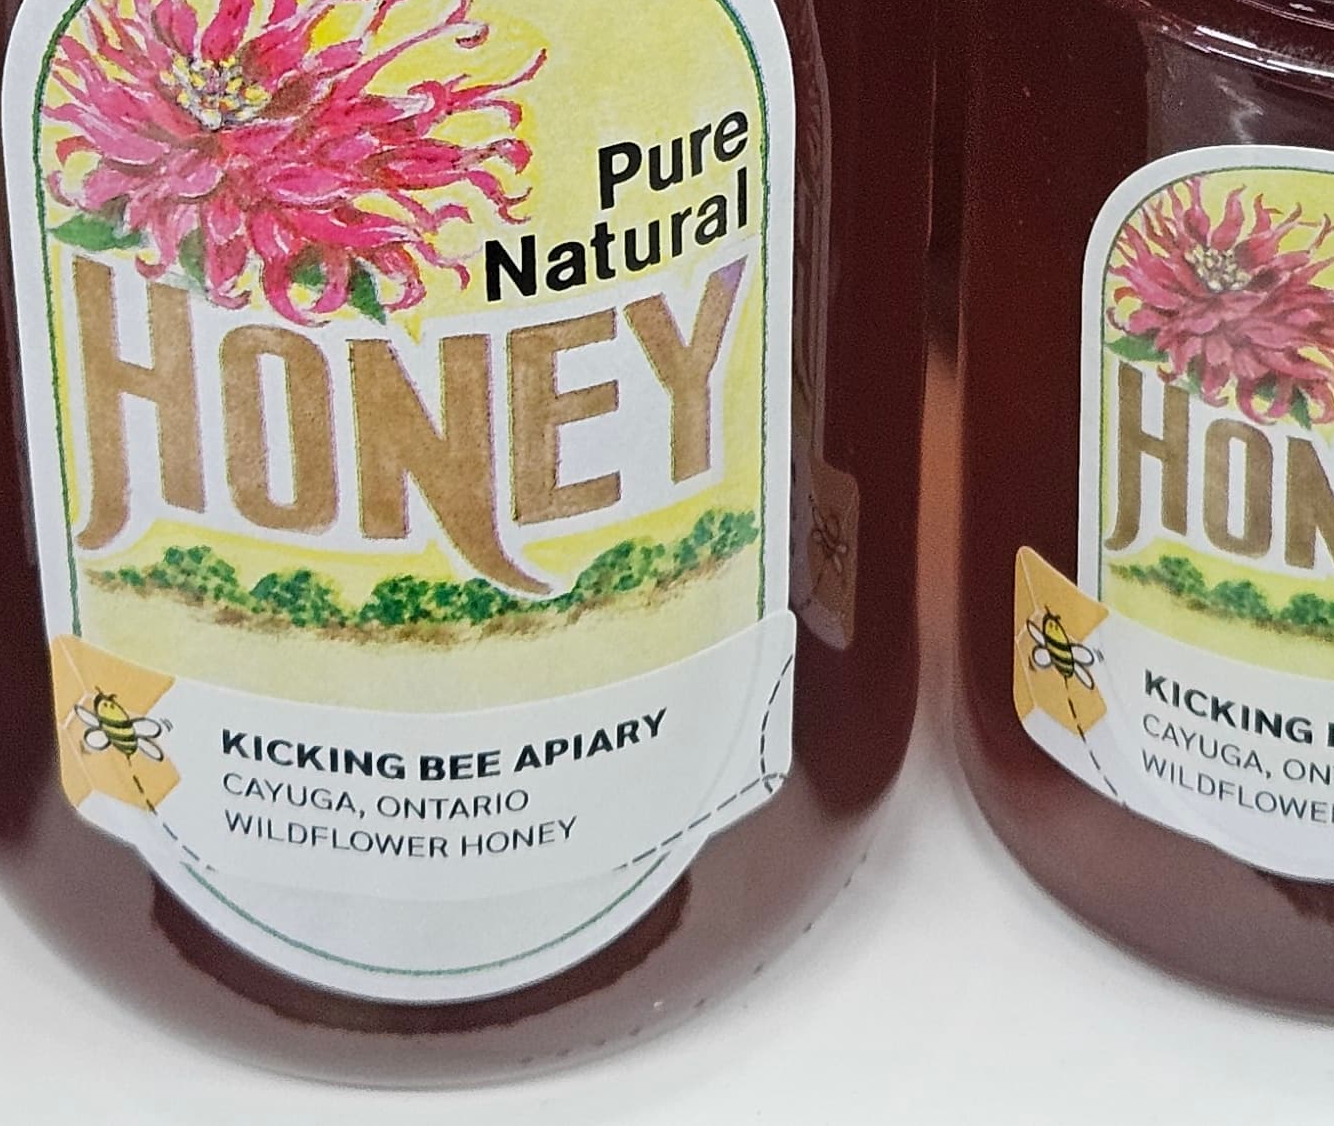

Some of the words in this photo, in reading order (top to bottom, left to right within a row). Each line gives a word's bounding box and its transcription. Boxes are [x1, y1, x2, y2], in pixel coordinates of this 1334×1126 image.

[598, 110, 750, 208] Pure
[485, 168, 750, 302] Natural
[72, 255, 750, 595] HONEY
[1144, 669, 1313, 745] KICKING
[222, 729, 405, 780] KICKING
[420, 750, 501, 781] BEE
[513, 708, 667, 772] APIARY
[1142, 714, 1271, 779] CAYUGA,
[222, 773, 365, 819] CAYUGA,
[377, 789, 529, 820] ONTARIO
[224, 810, 448, 857] WILDFLOWER
[461, 816, 577, 857] HONEY
